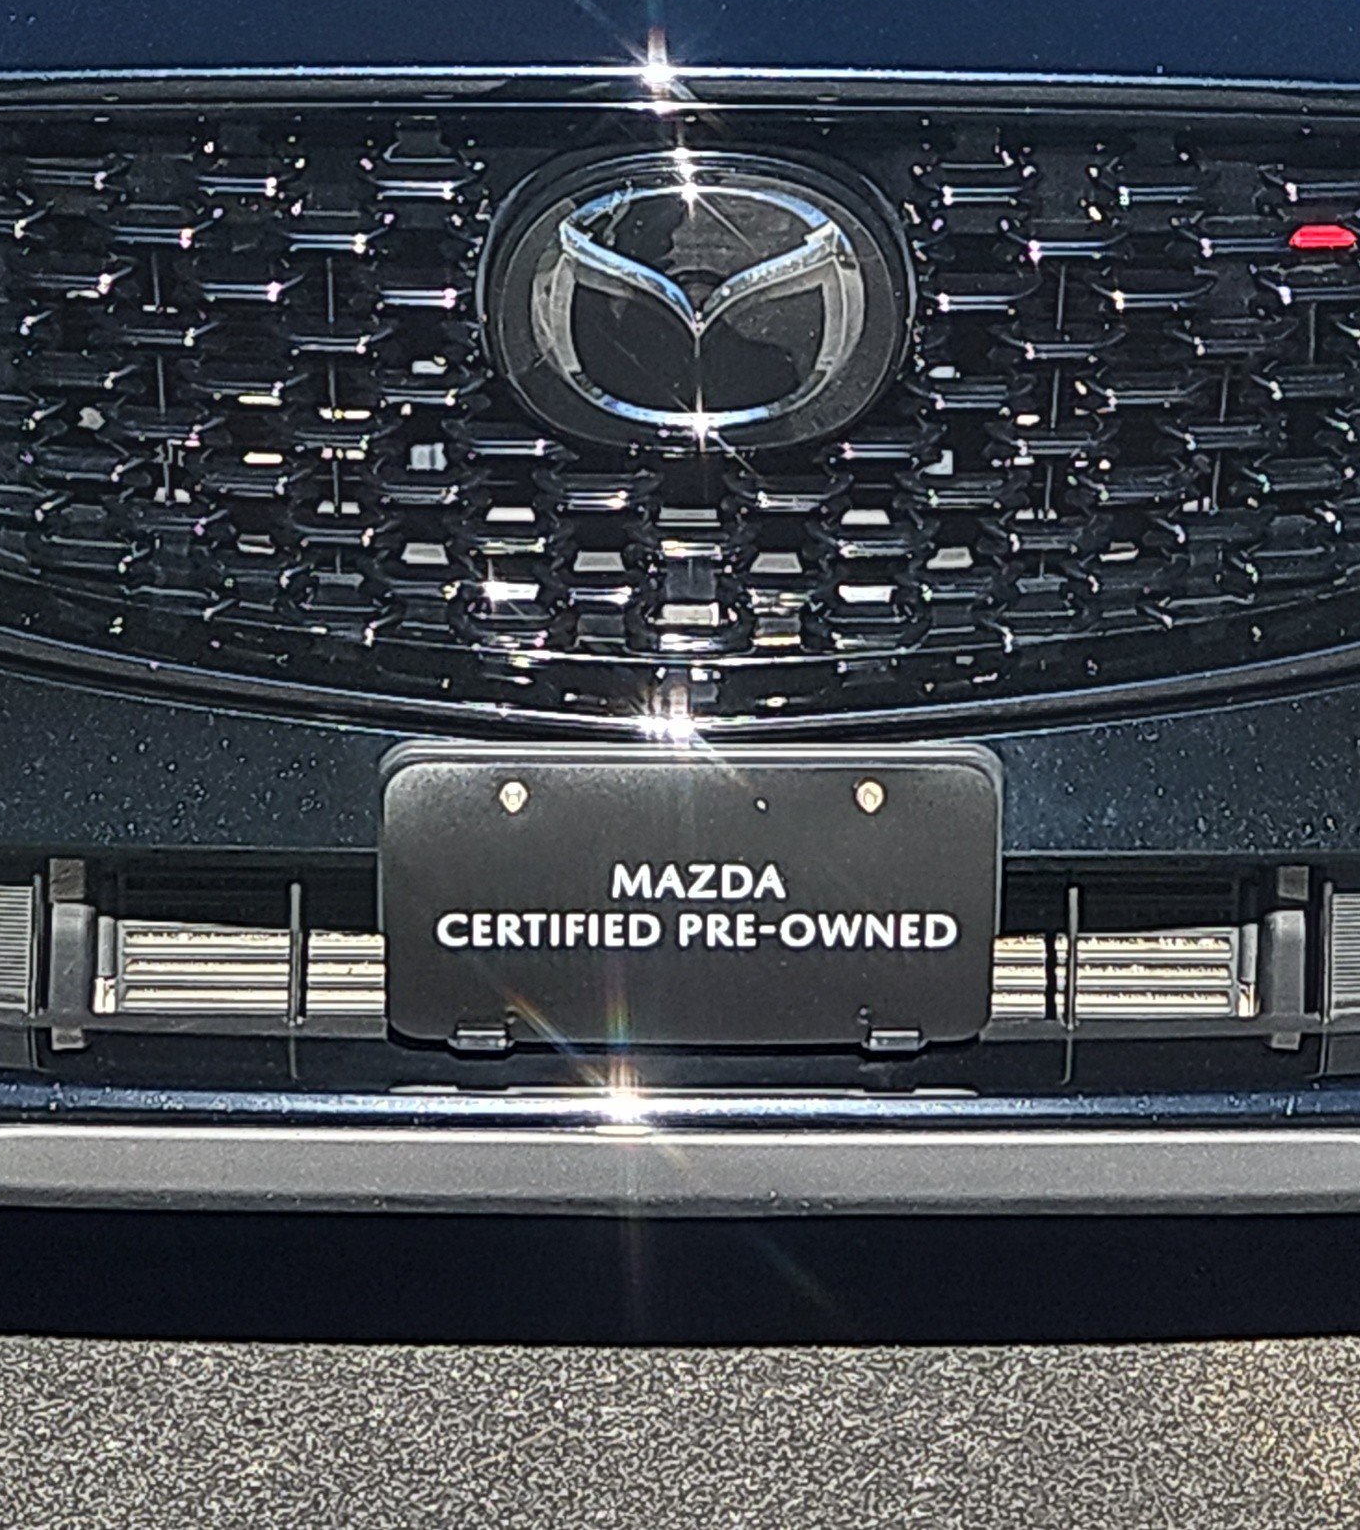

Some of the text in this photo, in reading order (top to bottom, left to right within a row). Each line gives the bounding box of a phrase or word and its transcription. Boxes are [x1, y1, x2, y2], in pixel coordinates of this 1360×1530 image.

[611, 863, 787, 899] MAZDA
[436, 913, 958, 948] CERTIFIED PRE-OWNED
